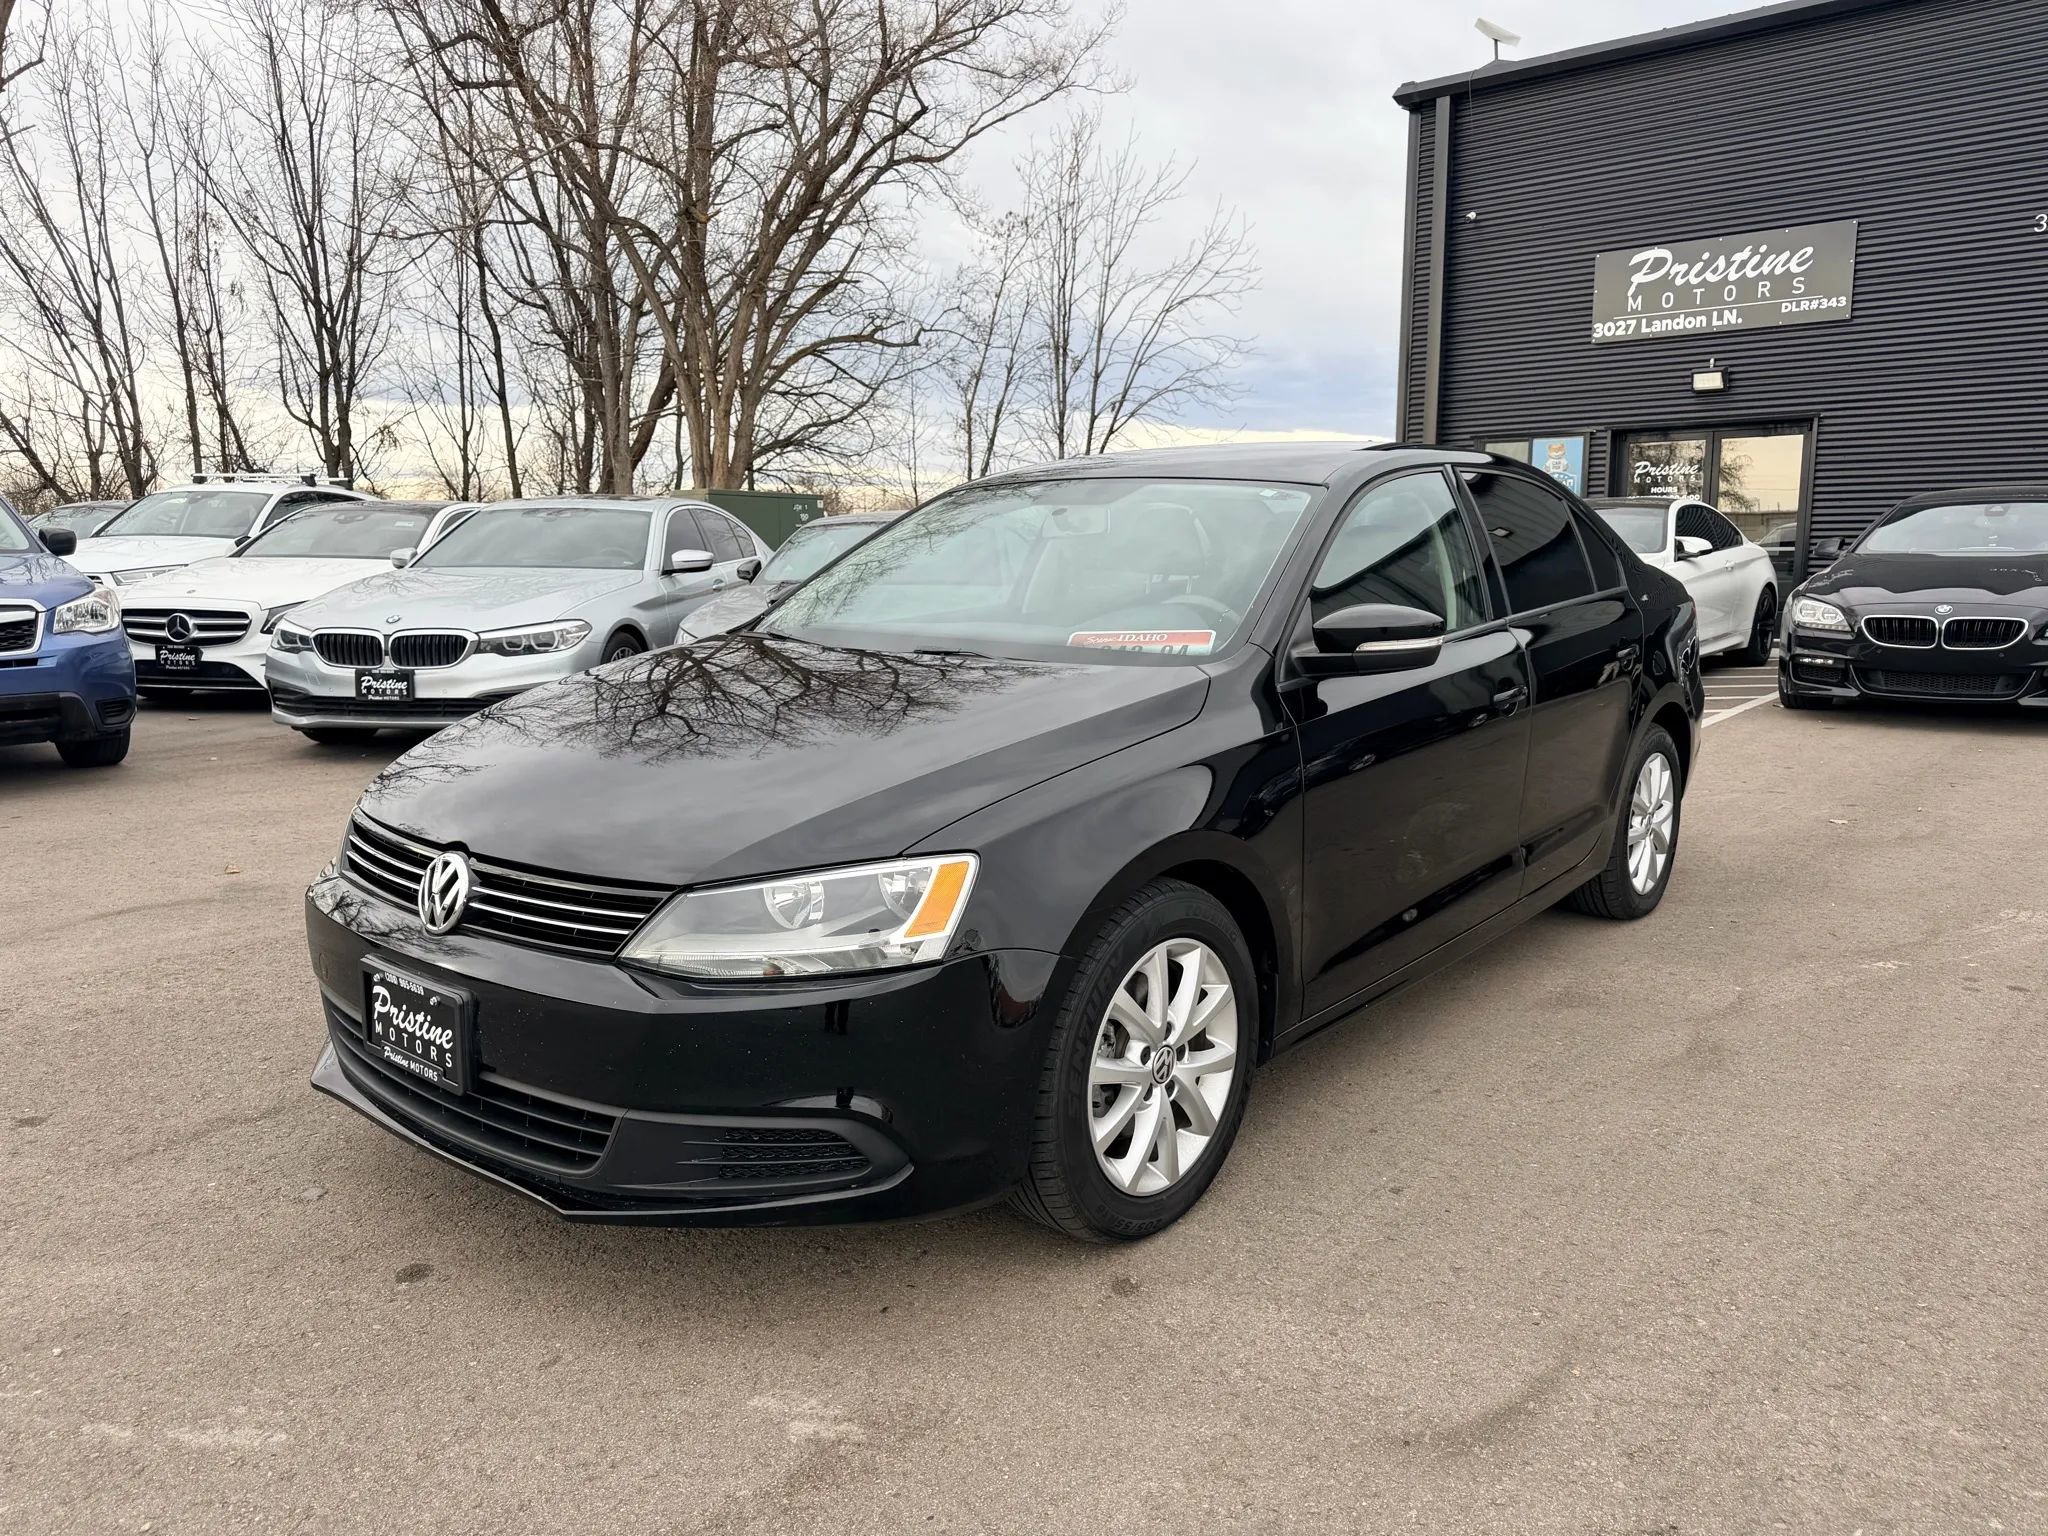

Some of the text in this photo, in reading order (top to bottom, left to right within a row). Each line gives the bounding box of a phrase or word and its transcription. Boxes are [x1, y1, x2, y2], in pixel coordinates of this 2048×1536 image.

[2034, 214, 2048, 232] 3
[1628, 244, 1814, 297] Pristine
[1628, 276, 1805, 312] MOTORS
[1781, 296, 1847, 313] DLR#343
[1593, 309, 1743, 338] 3027 Landon LN.
[1634, 461, 1699, 478] Pristine
[1634, 475, 1696, 483] MOTORS
[1118, 633, 1168, 642] IDAHO
[160, 650, 195, 661] Pristine
[361, 676, 408, 690] Pristine
[372, 985, 453, 1049] Pristine
[375, 1020, 453, 1068] MOTORS
[384, 1046, 438, 1082] Pristine MOTORS
